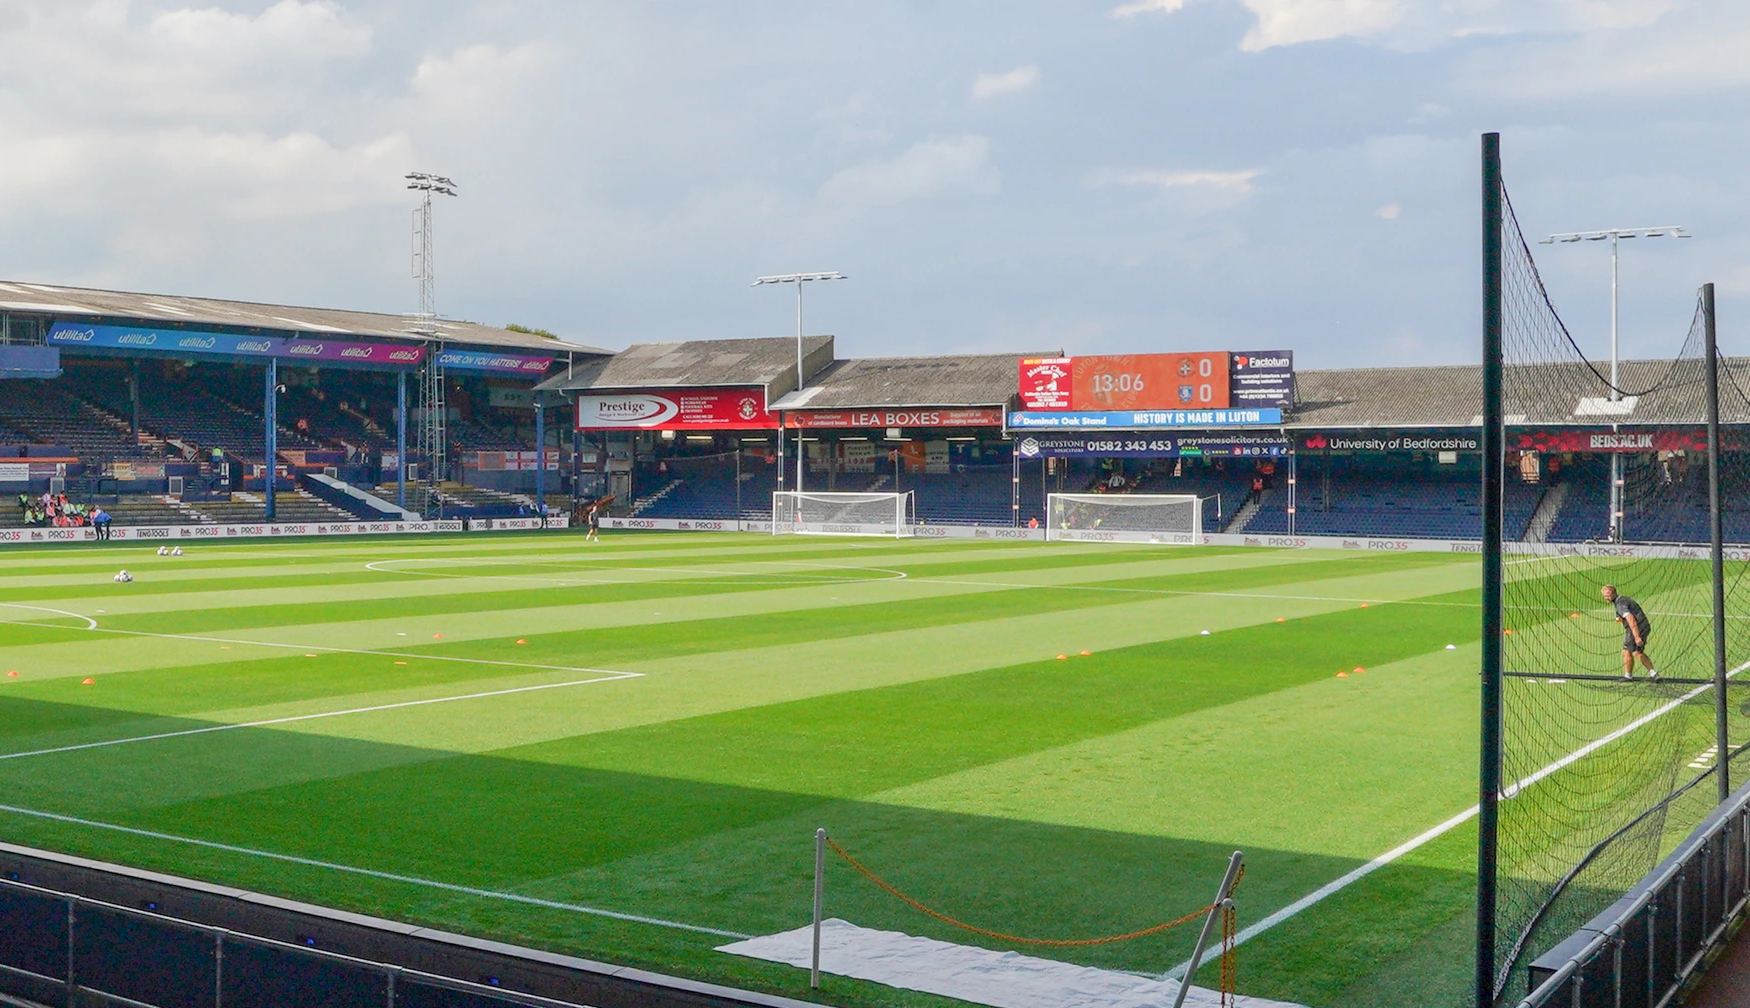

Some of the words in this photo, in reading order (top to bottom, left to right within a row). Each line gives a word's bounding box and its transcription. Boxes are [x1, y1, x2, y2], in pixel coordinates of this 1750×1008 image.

[53, 330, 83, 341] utilita
[117, 334, 146, 345] utilita
[439, 354, 462, 364] COME
[461, 355, 473, 365] ON
[473, 357, 490, 367] YOU
[490, 358, 522, 369] HATTERS!
[1249, 357, 1290, 368] Factotum
[1027, 365, 1049, 378] Master
[1050, 365, 1068, 378] Chef
[1199, 358, 1212, 377] 0
[1093, 373, 1145, 392] 13:06
[1199, 384, 1212, 402] 0
[599, 401, 645, 413] Prestige
[851, 413, 881, 426] LEA
[885, 412, 940, 425] BOXES
[1023, 417, 1059, 425] Domino's
[1061, 417, 1080, 425] Oak
[1081, 416, 1107, 424] Stand
[1134, 413, 1173, 424] HISTORY
[1175, 413, 1185, 423] IS
[1187, 412, 1214, 423] MADE
[1216, 411, 1226, 422] IN
[1229, 411, 1260, 422] LUTON
[1087, 440, 1122, 451] 01582
[1124, 440, 1147, 451] 343
[1148, 440, 1172, 451] 453
[1177, 435, 1288, 446] greystonesolicitors.co.uk
[1330, 438, 1387, 451] University
[1388, 438, 1400, 449] of
[1403, 437, 1477, 449] Bedfordshire
[1590, 434, 1653, 448] BEDS.AC.UK
[284, 525, 306, 534] PRO35
[330, 525, 351, 533] PRO35
[369, 524, 390, 532] PRO35
[628, 520, 654, 528] PRO35
[695, 522, 721, 530] PRO35
[49, 530, 74, 539] PRO35
[195, 527, 218, 535] PRO35
[241, 526, 263, 534] PRO35
[914, 527, 945, 536] PRO35
[996, 530, 1027, 538] PRO35
[1268, 538, 1305, 546] PRO35
[1368, 541, 1408, 549] PRO35
